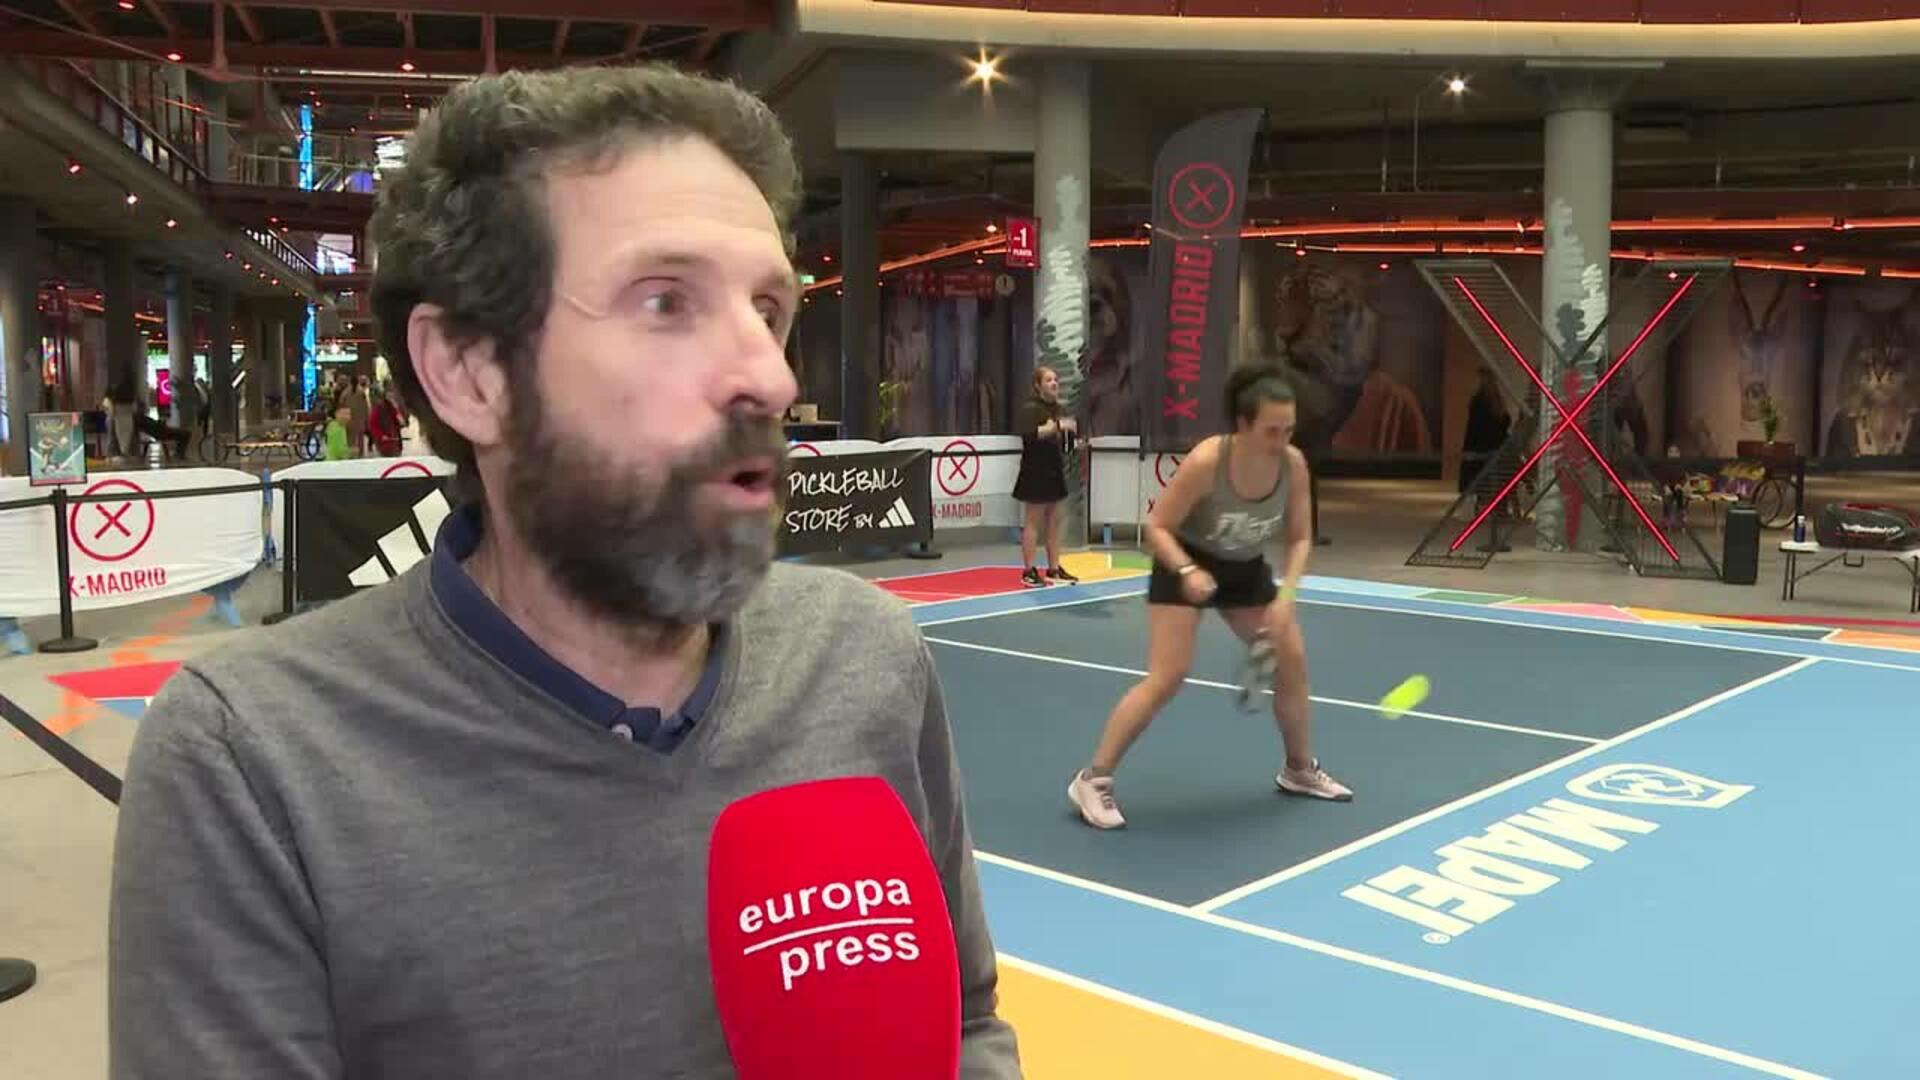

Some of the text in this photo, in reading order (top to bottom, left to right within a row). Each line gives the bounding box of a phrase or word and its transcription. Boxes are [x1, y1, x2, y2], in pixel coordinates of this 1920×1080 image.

[1013, 227, 1027, 248] -1
[1163, 244, 1214, 421] X-MADRID
[786, 467, 904, 497] PICKLEBALL
[785, 503, 874, 534] STORE BY
[1340, 797, 1661, 937] MAPEI
[738, 878, 912, 934] europa
[778, 931, 920, 991] press
